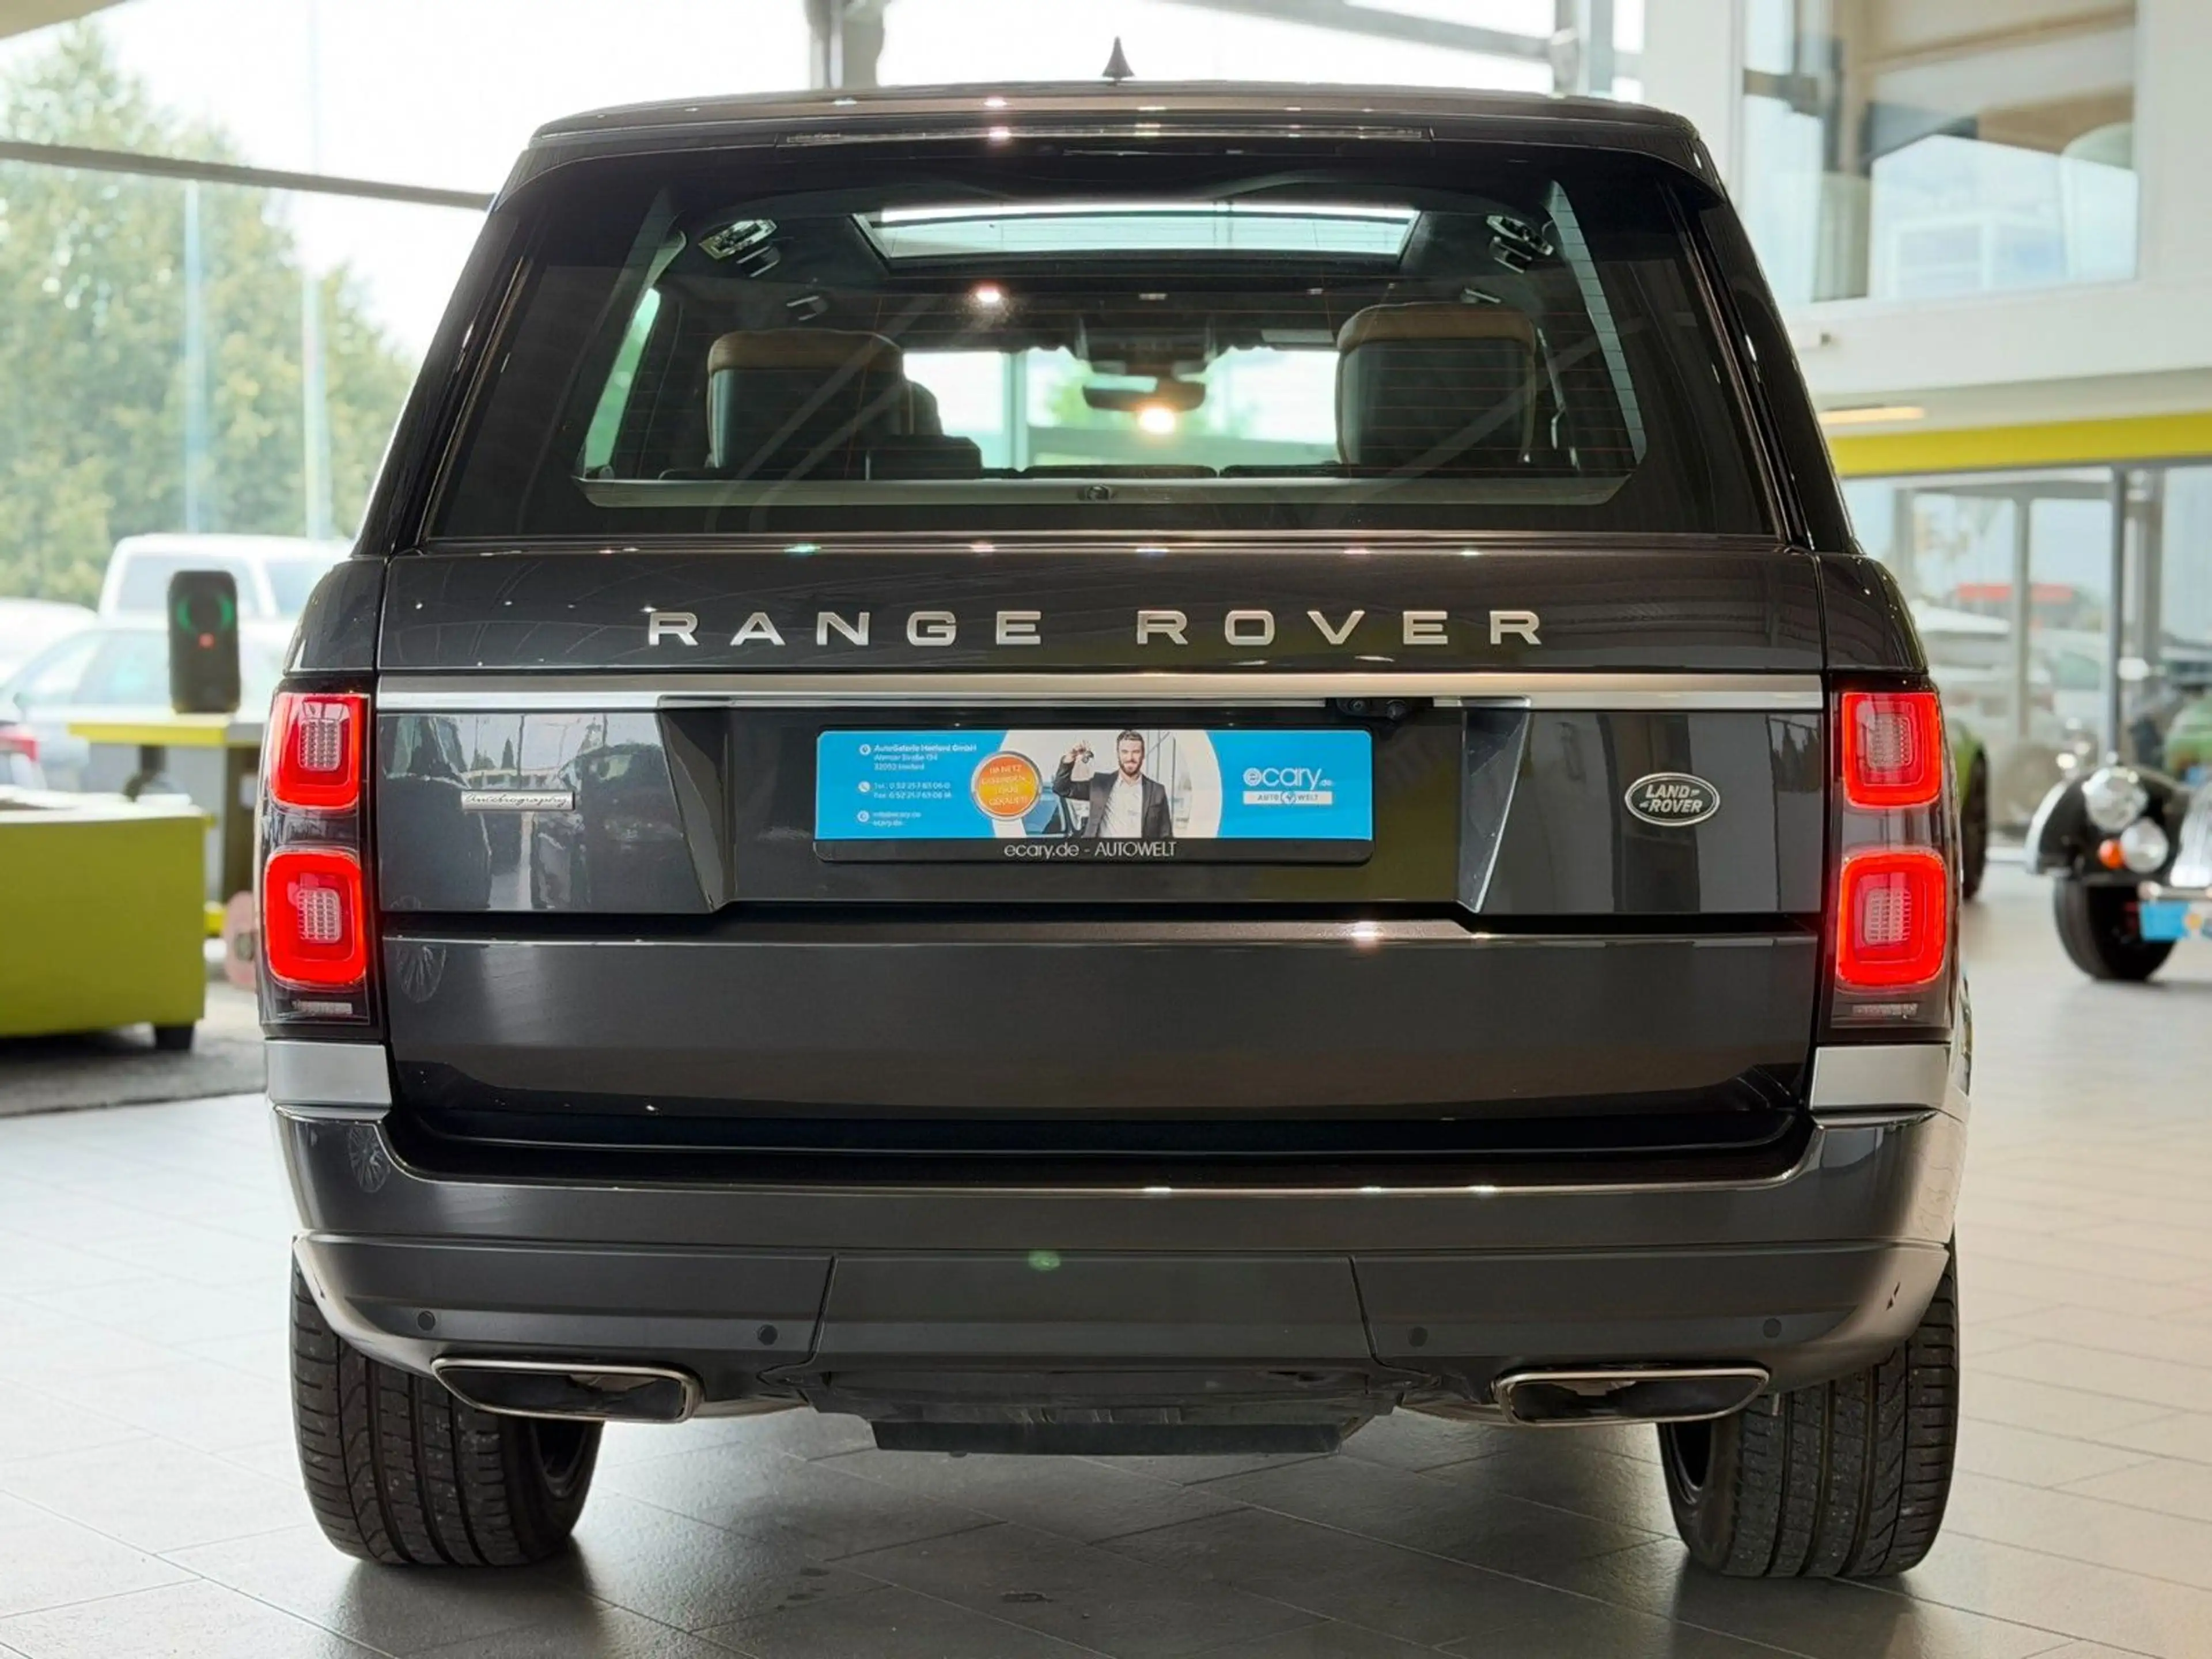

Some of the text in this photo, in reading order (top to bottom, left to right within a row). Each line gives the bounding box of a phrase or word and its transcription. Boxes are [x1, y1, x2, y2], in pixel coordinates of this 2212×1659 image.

[648, 609, 1542, 646] RANGE ROVER
[1645, 784, 1691, 798] LAND
[1648, 798, 1703, 813] ROVER
[1003, 842, 1080, 859] ecary.de
[1094, 841, 1177, 857] AUTOWELT
